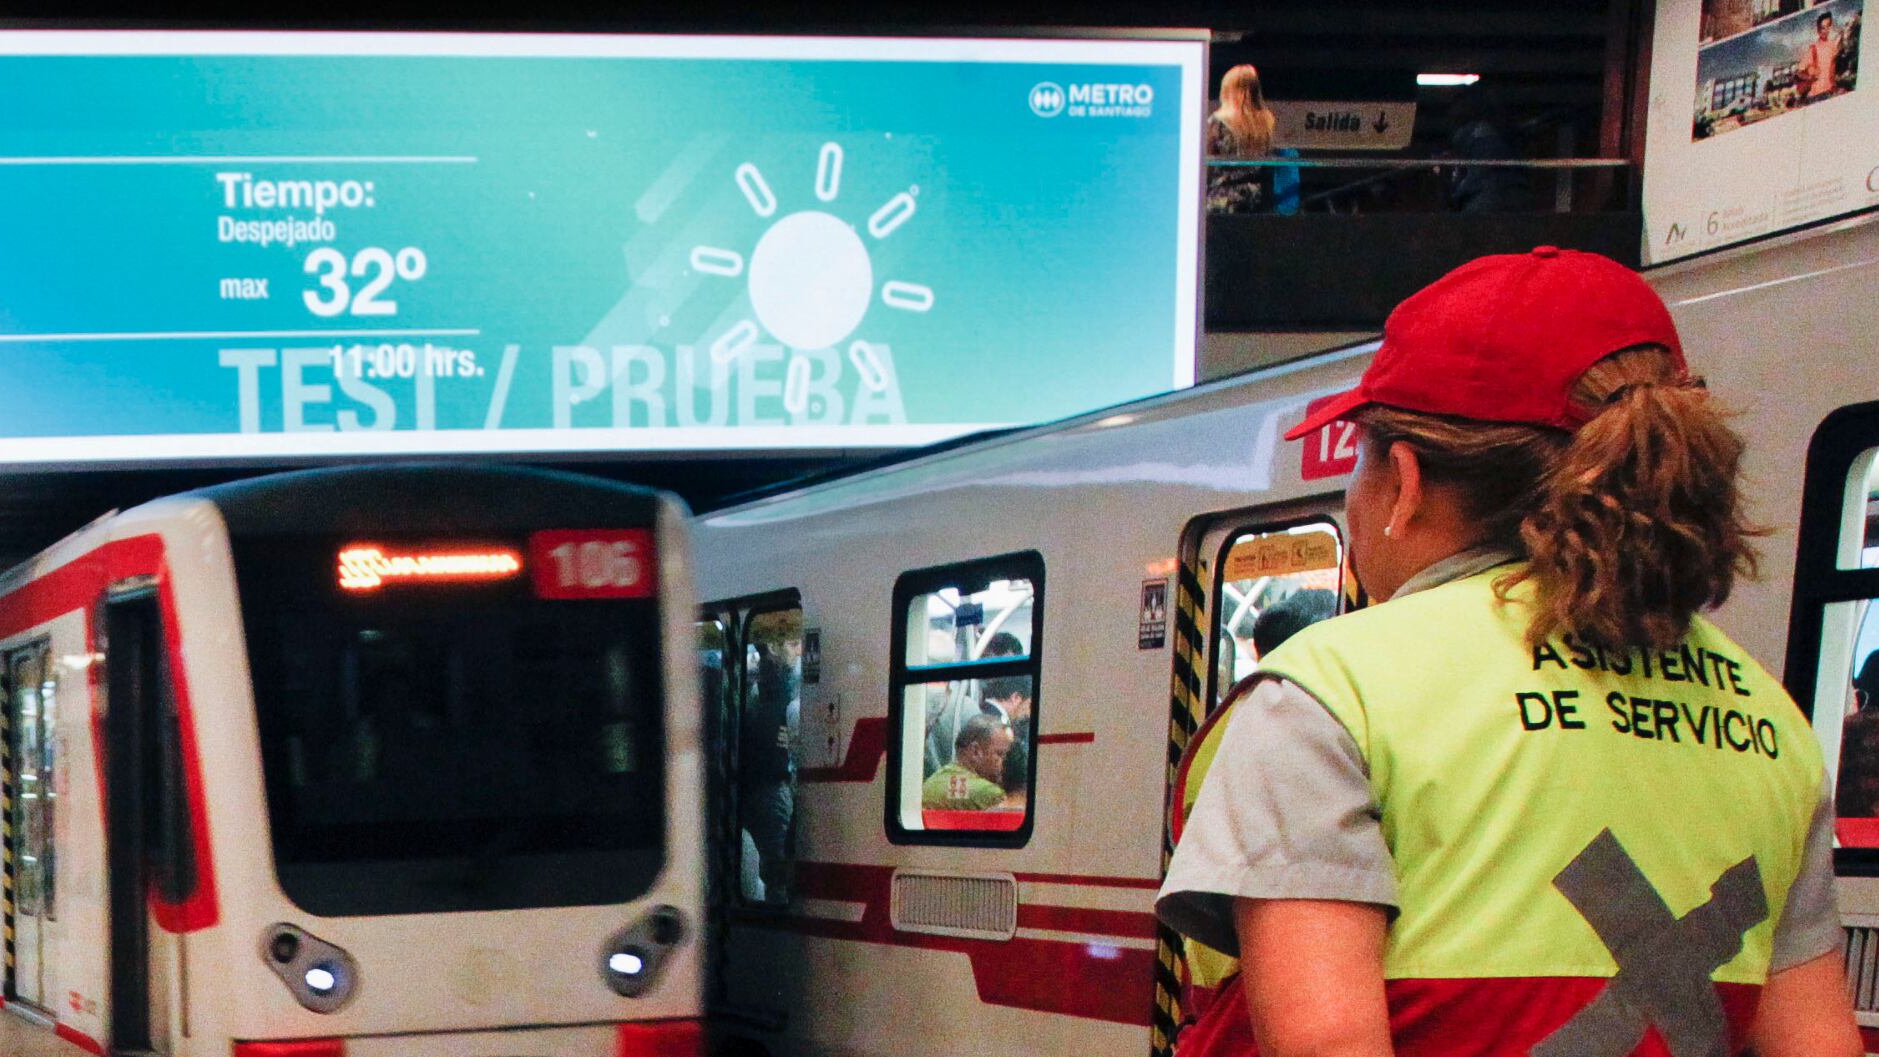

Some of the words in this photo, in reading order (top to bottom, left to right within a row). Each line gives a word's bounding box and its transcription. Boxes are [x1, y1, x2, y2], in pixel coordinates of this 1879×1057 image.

[1068, 83, 1154, 105] METRO
[1068, 105, 1086, 117] DE
[1304, 111, 1361, 132] Salida
[216, 172, 376, 215] Tiempo:
[218, 215, 337, 248] Despejado
[220, 277, 269, 300] max
[329, 343, 417, 379] 11:00
[423, 343, 486, 378] hrs.
[219, 346, 452, 433] TEST
[551, 342, 908, 430] PRUEBA
[1319, 419, 1360, 462] 12
[1515, 689, 1587, 731] DE
[1606, 690, 1779, 761] SERVICIO
